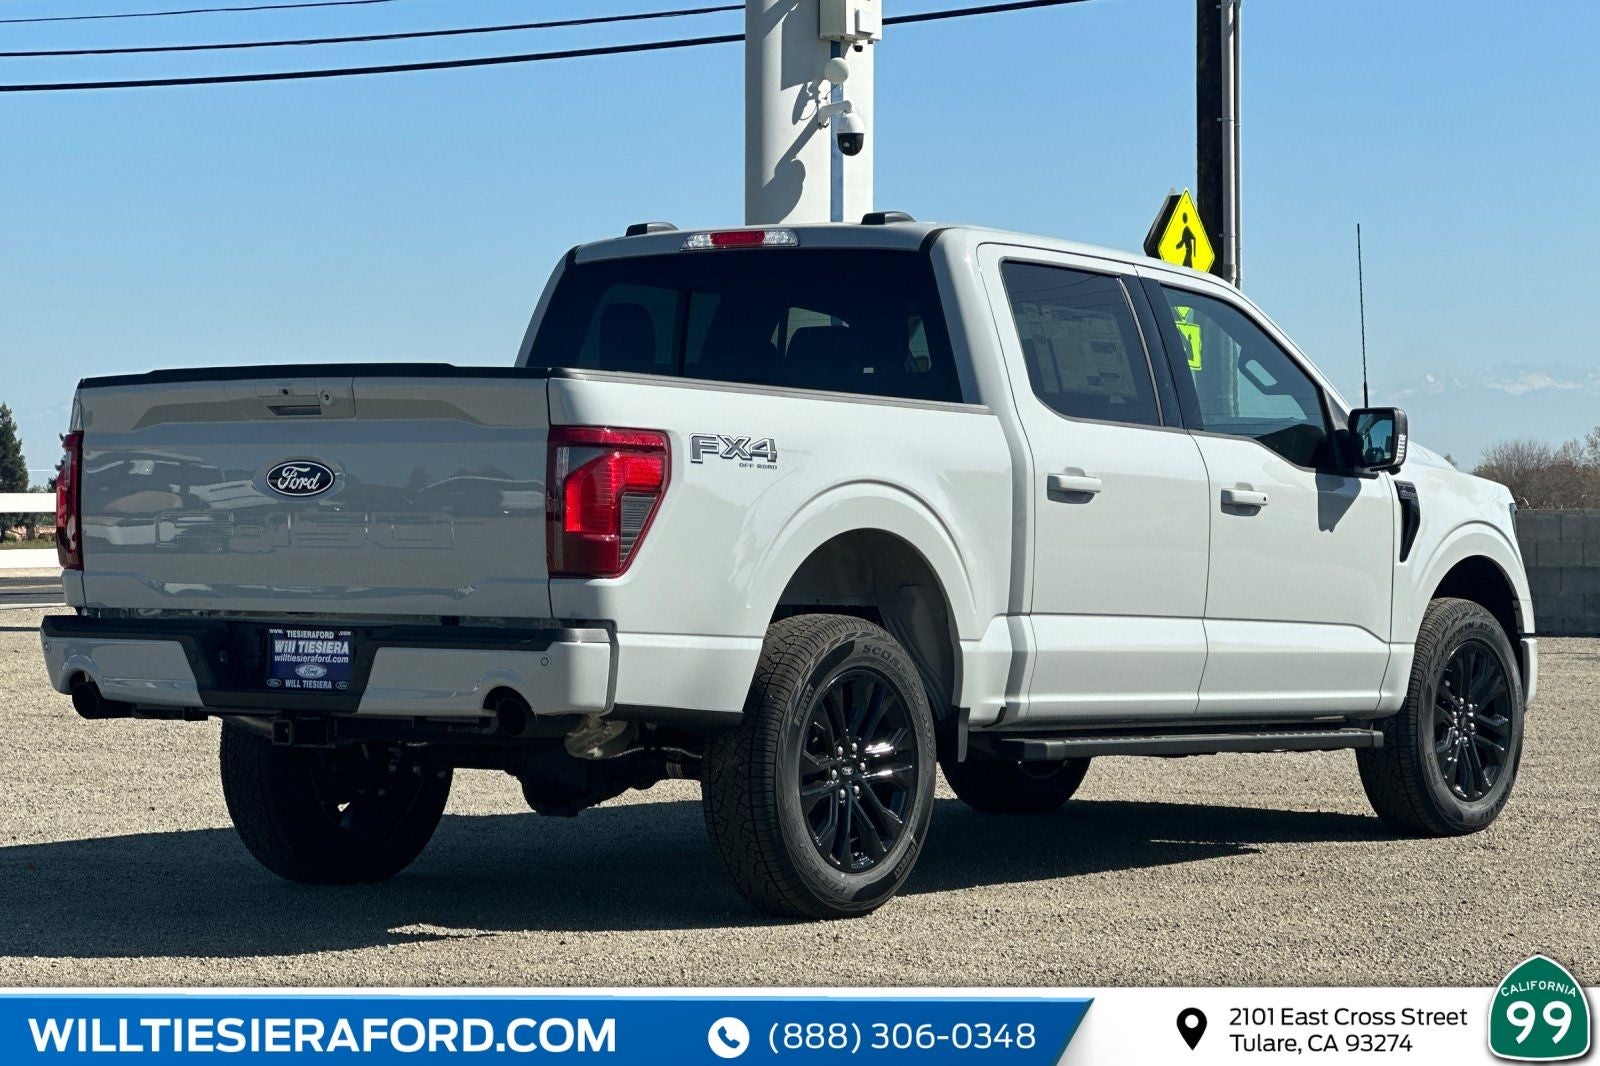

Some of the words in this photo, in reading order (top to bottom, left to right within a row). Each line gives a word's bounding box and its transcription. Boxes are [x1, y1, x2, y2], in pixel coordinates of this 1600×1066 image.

[689, 433, 777, 464] FX4
[278, 466, 321, 490] Ford
[286, 630, 335, 639] TIESIERAFORD
[298, 640, 349, 654] TIESIERA
[274, 653, 349, 663] willtiesieraford.com
[285, 679, 301, 688] WILL
[302, 680, 332, 689] TIESIERA
